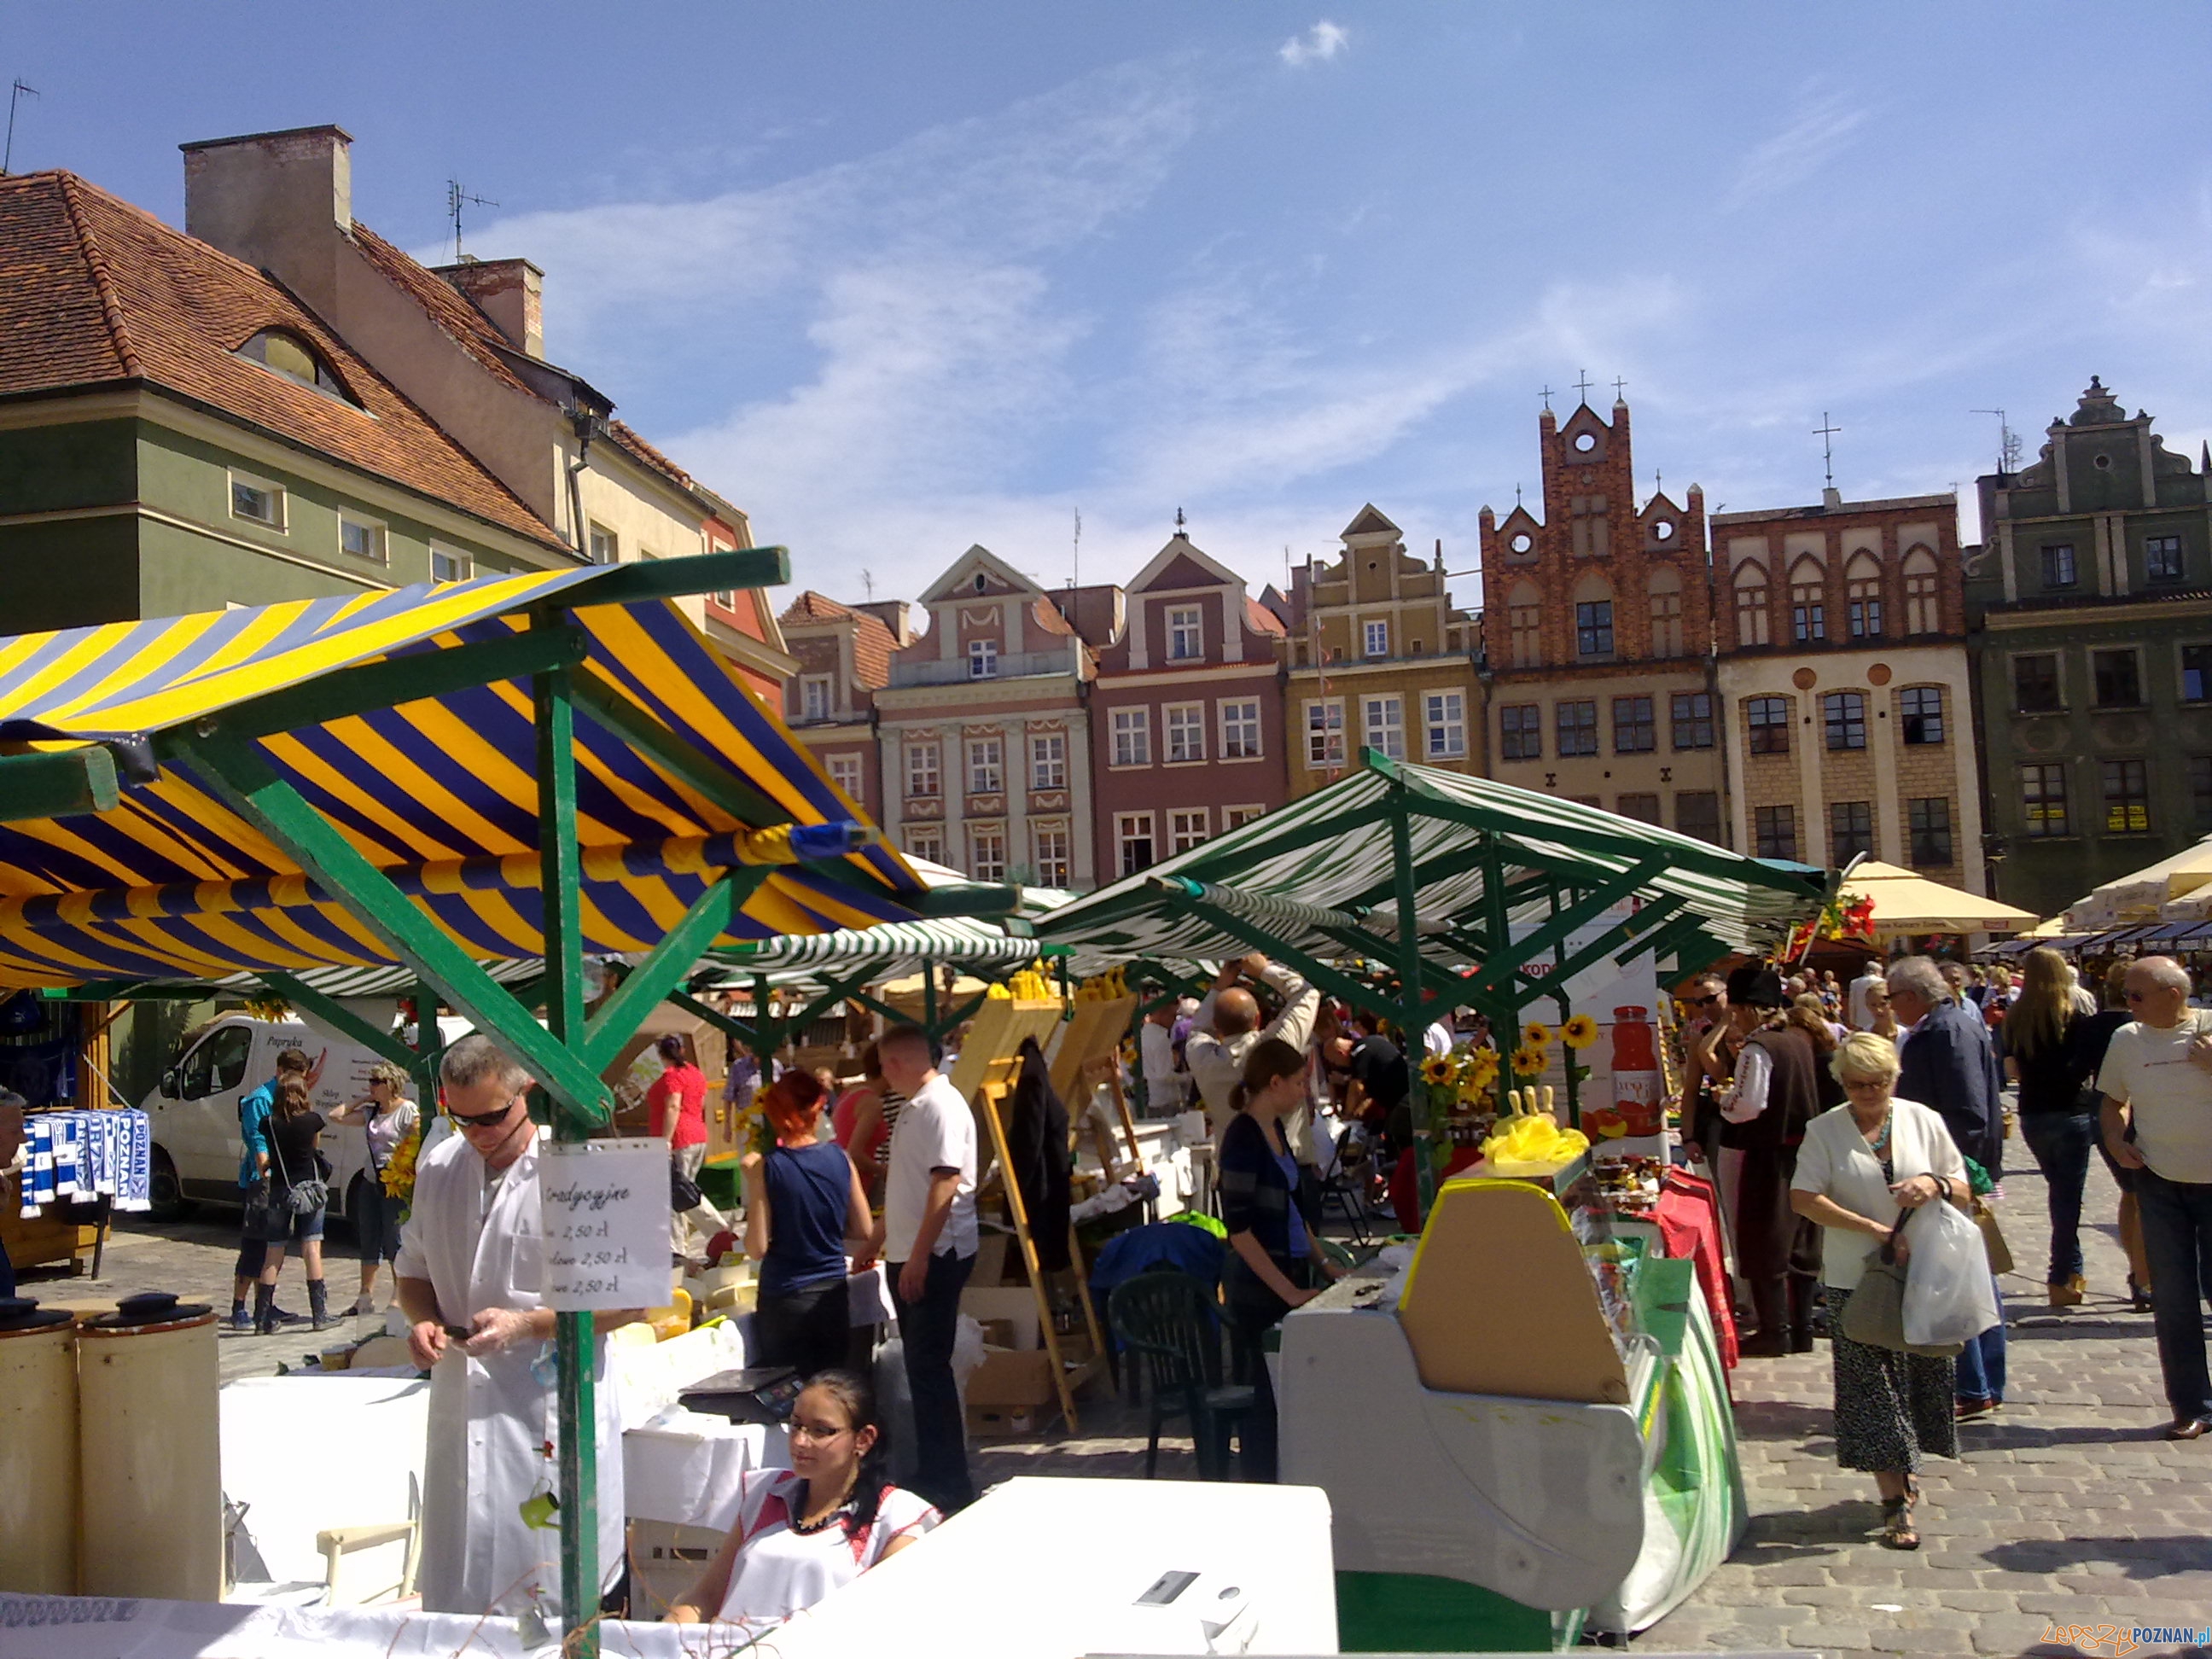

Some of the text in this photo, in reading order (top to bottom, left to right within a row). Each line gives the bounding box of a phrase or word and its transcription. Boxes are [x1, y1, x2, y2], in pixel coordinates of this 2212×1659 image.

[562, 1225, 592, 1242] 2,50
[581, 1251, 612, 1267] 2,50
[573, 1279, 602, 1296] 2,50
